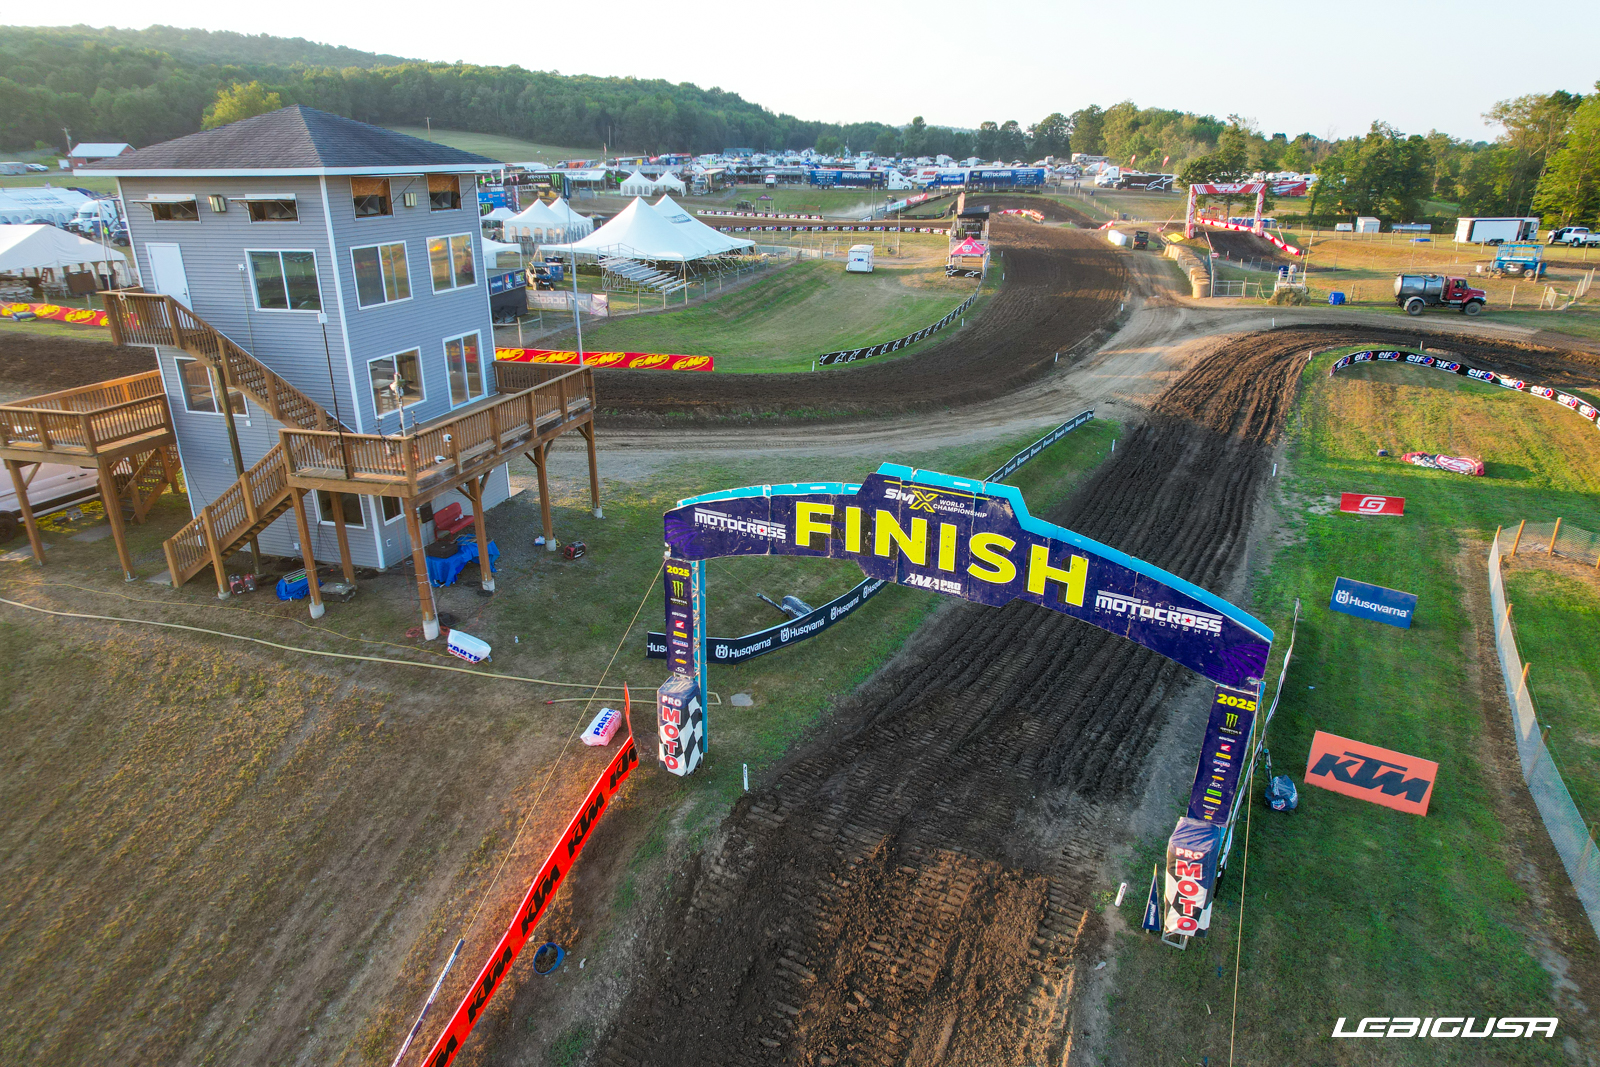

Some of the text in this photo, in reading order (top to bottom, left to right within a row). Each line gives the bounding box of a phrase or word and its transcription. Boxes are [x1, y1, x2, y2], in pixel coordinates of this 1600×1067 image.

[583, 352, 626, 366] FMF
[629, 354, 670, 368] FMF
[672, 356, 710, 370] FMF
[884, 488, 938, 513] SMX
[933, 504, 988, 518] CHAMPIONSHIP
[940, 499, 965, 508] WORLD
[694, 512, 786, 540] MOTOCROSS
[728, 514, 752, 523] PRO
[694, 522, 786, 544] CHAMPIONSHIP
[796, 500, 1090, 608] FINISH
[666, 565, 690, 577] 2025
[904, 572, 940, 590] AMA
[940, 580, 962, 591] PRO
[1095, 595, 1223, 633] MOTOCROSS
[1142, 599, 1176, 611] PRO
[1349, 596, 1407, 618] Husqvarna
[790, 618, 825, 638] Husqvarna
[1094, 606, 1221, 638] CHAMPIONSHIP
[729, 638, 772, 658] Husqvarna
[661, 695, 682, 707] PRO
[1216, 693, 1257, 711] 2025
[593, 709, 615, 736] PARTS
[662, 706, 681, 770] MOTO
[610, 743, 637, 790] KTM
[1310, 751, 1431, 804] KTM
[568, 792, 606, 859] KTM
[1176, 847, 1204, 860] PRO
[522, 864, 561, 938] KTM
[1175, 858, 1203, 932] MOTO
[468, 946, 513, 1025] KTM
